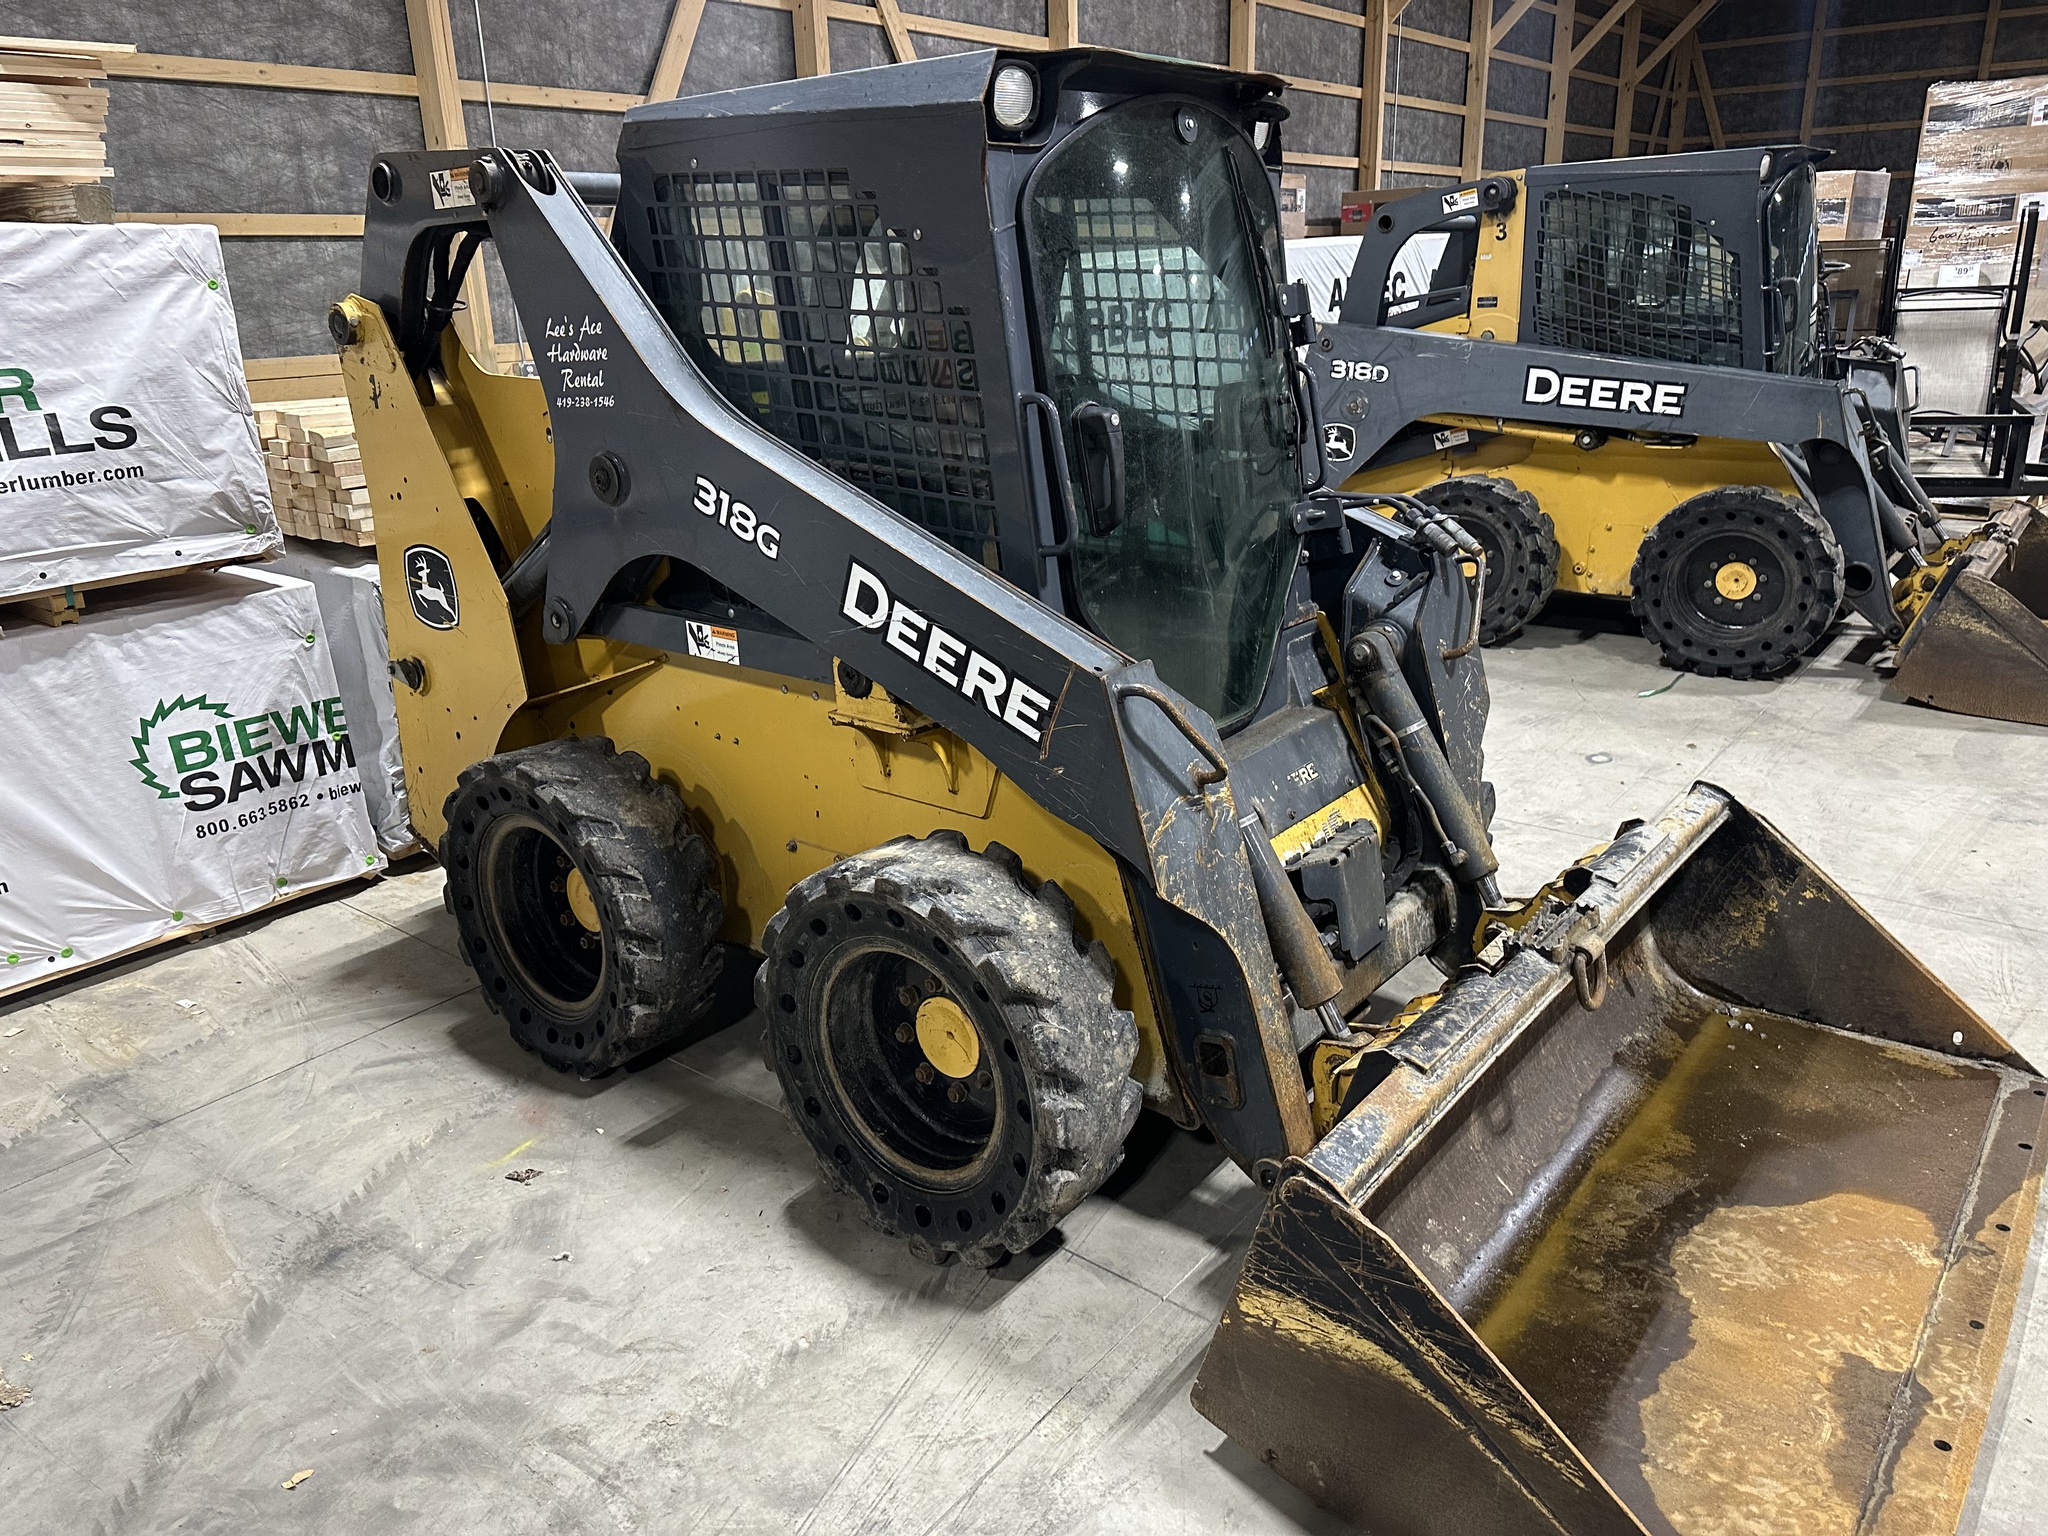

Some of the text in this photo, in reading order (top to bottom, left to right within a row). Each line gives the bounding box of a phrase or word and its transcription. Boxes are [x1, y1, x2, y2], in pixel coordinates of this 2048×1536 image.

[1494, 222, 1508, 241] 3
[545, 315, 603, 342] Lee's Ace
[546, 342, 608, 363] Hardware
[560, 368, 605, 392] Rental
[1330, 360, 1389, 384] 318D
[556, 395, 615, 408] 419-238-1546
[1525, 367, 1686, 416] DEERE
[0, 406, 138, 461] LLS
[693, 476, 781, 560] 318G
[842, 562, 1051, 743] DEERE
